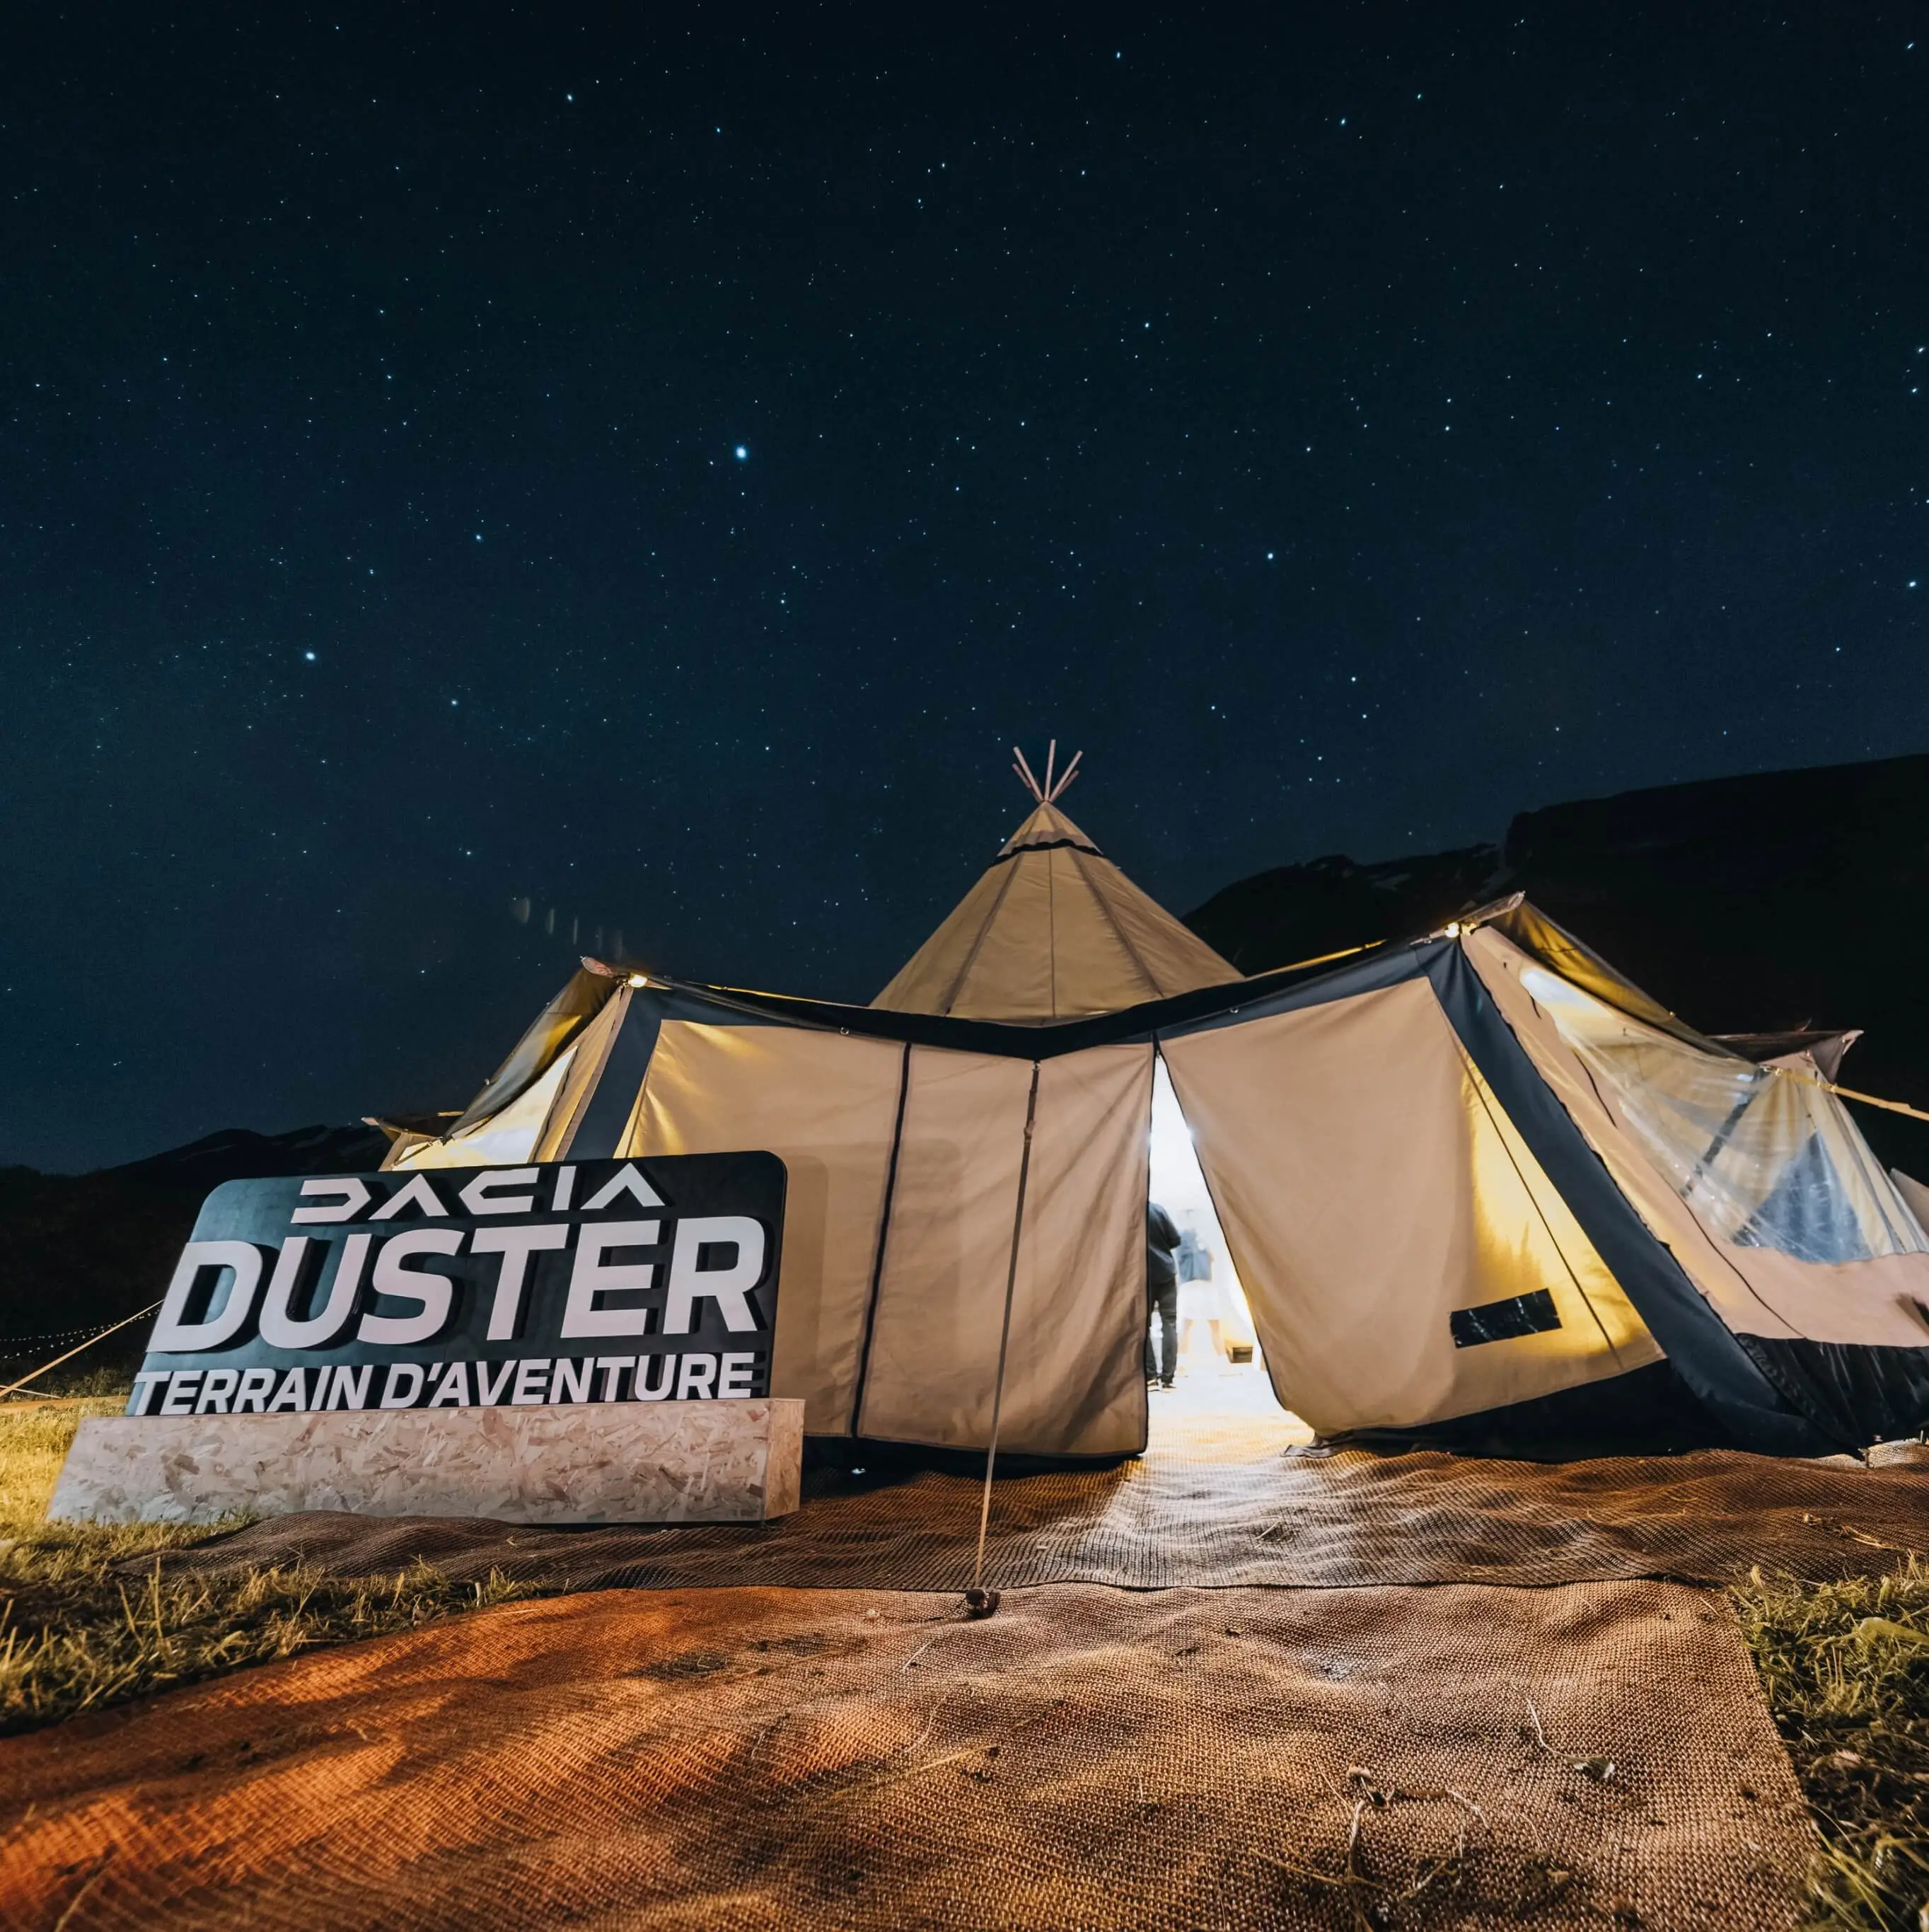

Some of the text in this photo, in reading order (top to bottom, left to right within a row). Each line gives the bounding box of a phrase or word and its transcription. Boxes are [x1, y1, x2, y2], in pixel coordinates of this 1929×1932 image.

[291, 1162, 666, 1224] DACIA
[146, 1216, 765, 1352] DUSTER
[134, 1352, 755, 1415] TERRAIN D'AVENTURE
